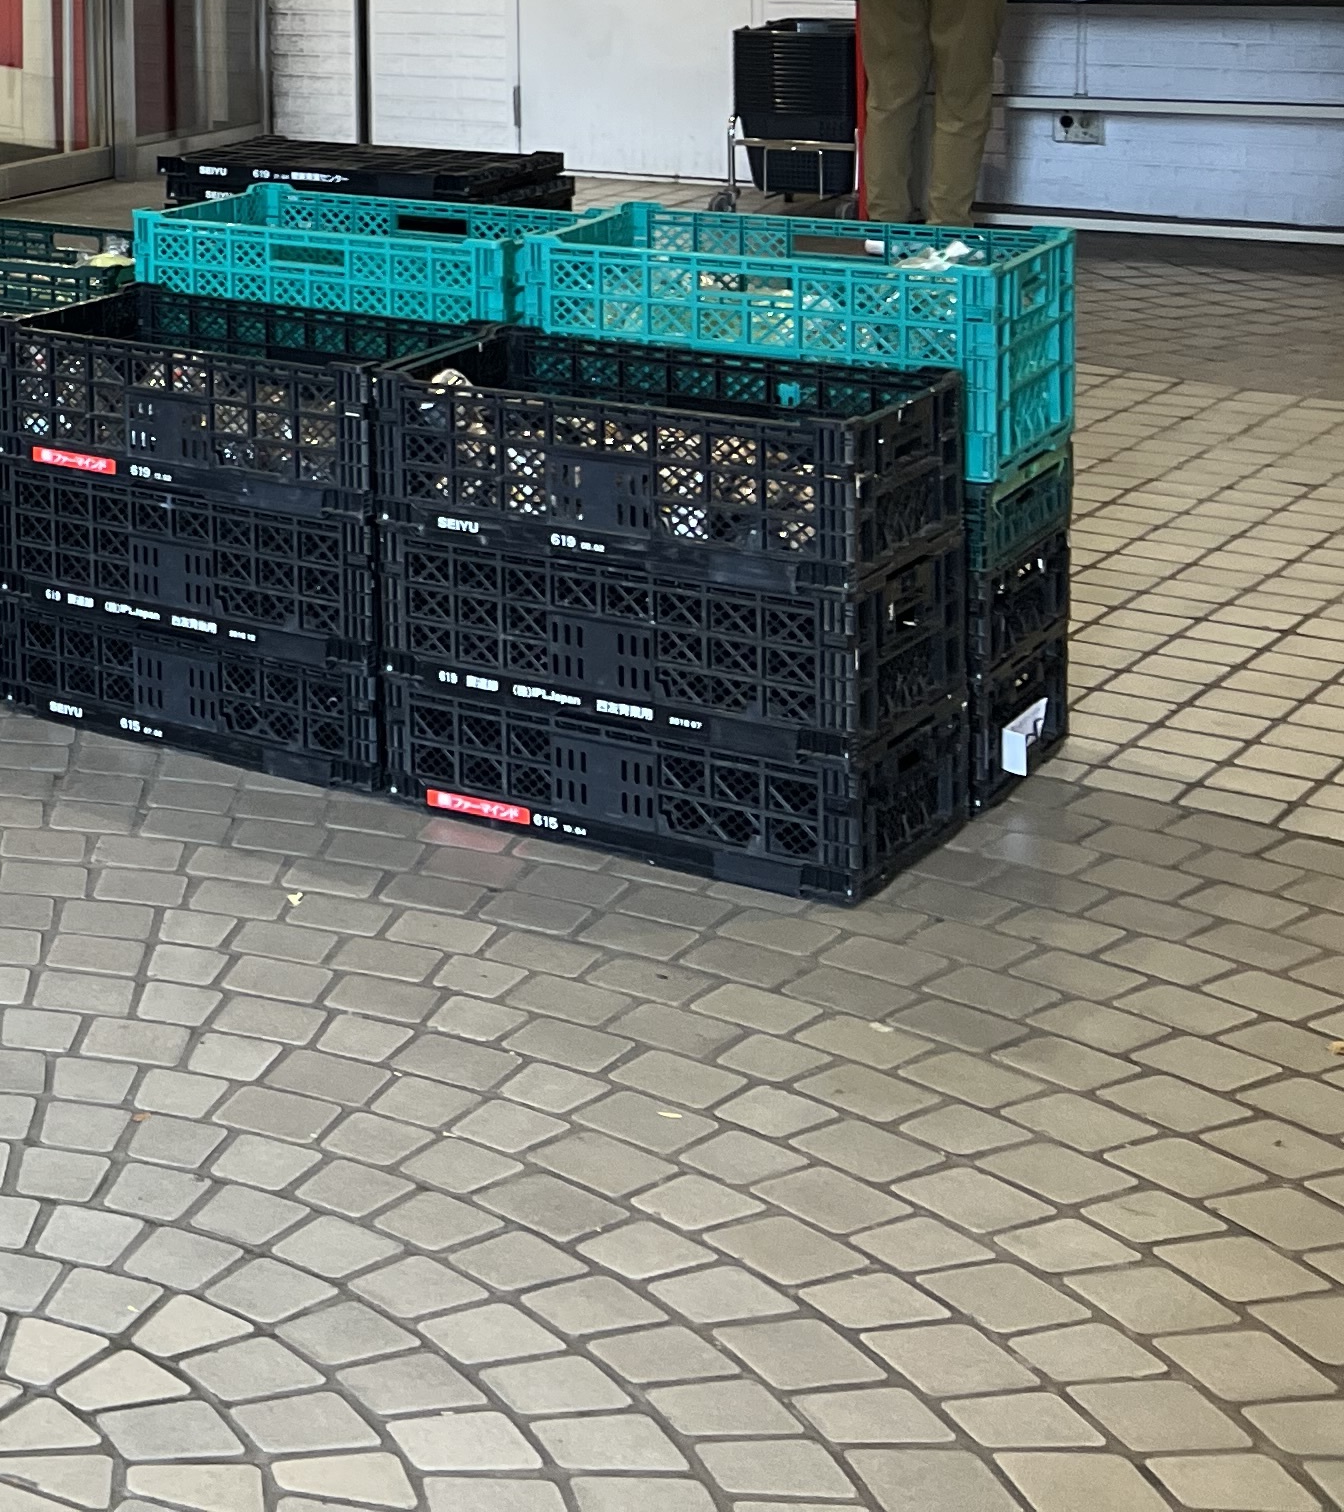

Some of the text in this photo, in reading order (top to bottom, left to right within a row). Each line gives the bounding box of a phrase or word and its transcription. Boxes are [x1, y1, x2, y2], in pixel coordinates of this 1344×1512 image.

[130, 464, 151, 478] 619
[437, 516, 479, 533] SEIYU
[550, 533, 576, 548] 619
[49, 701, 83, 718] SEIYU
[119, 717, 140, 732] 615
[533, 813, 559, 830] 615
